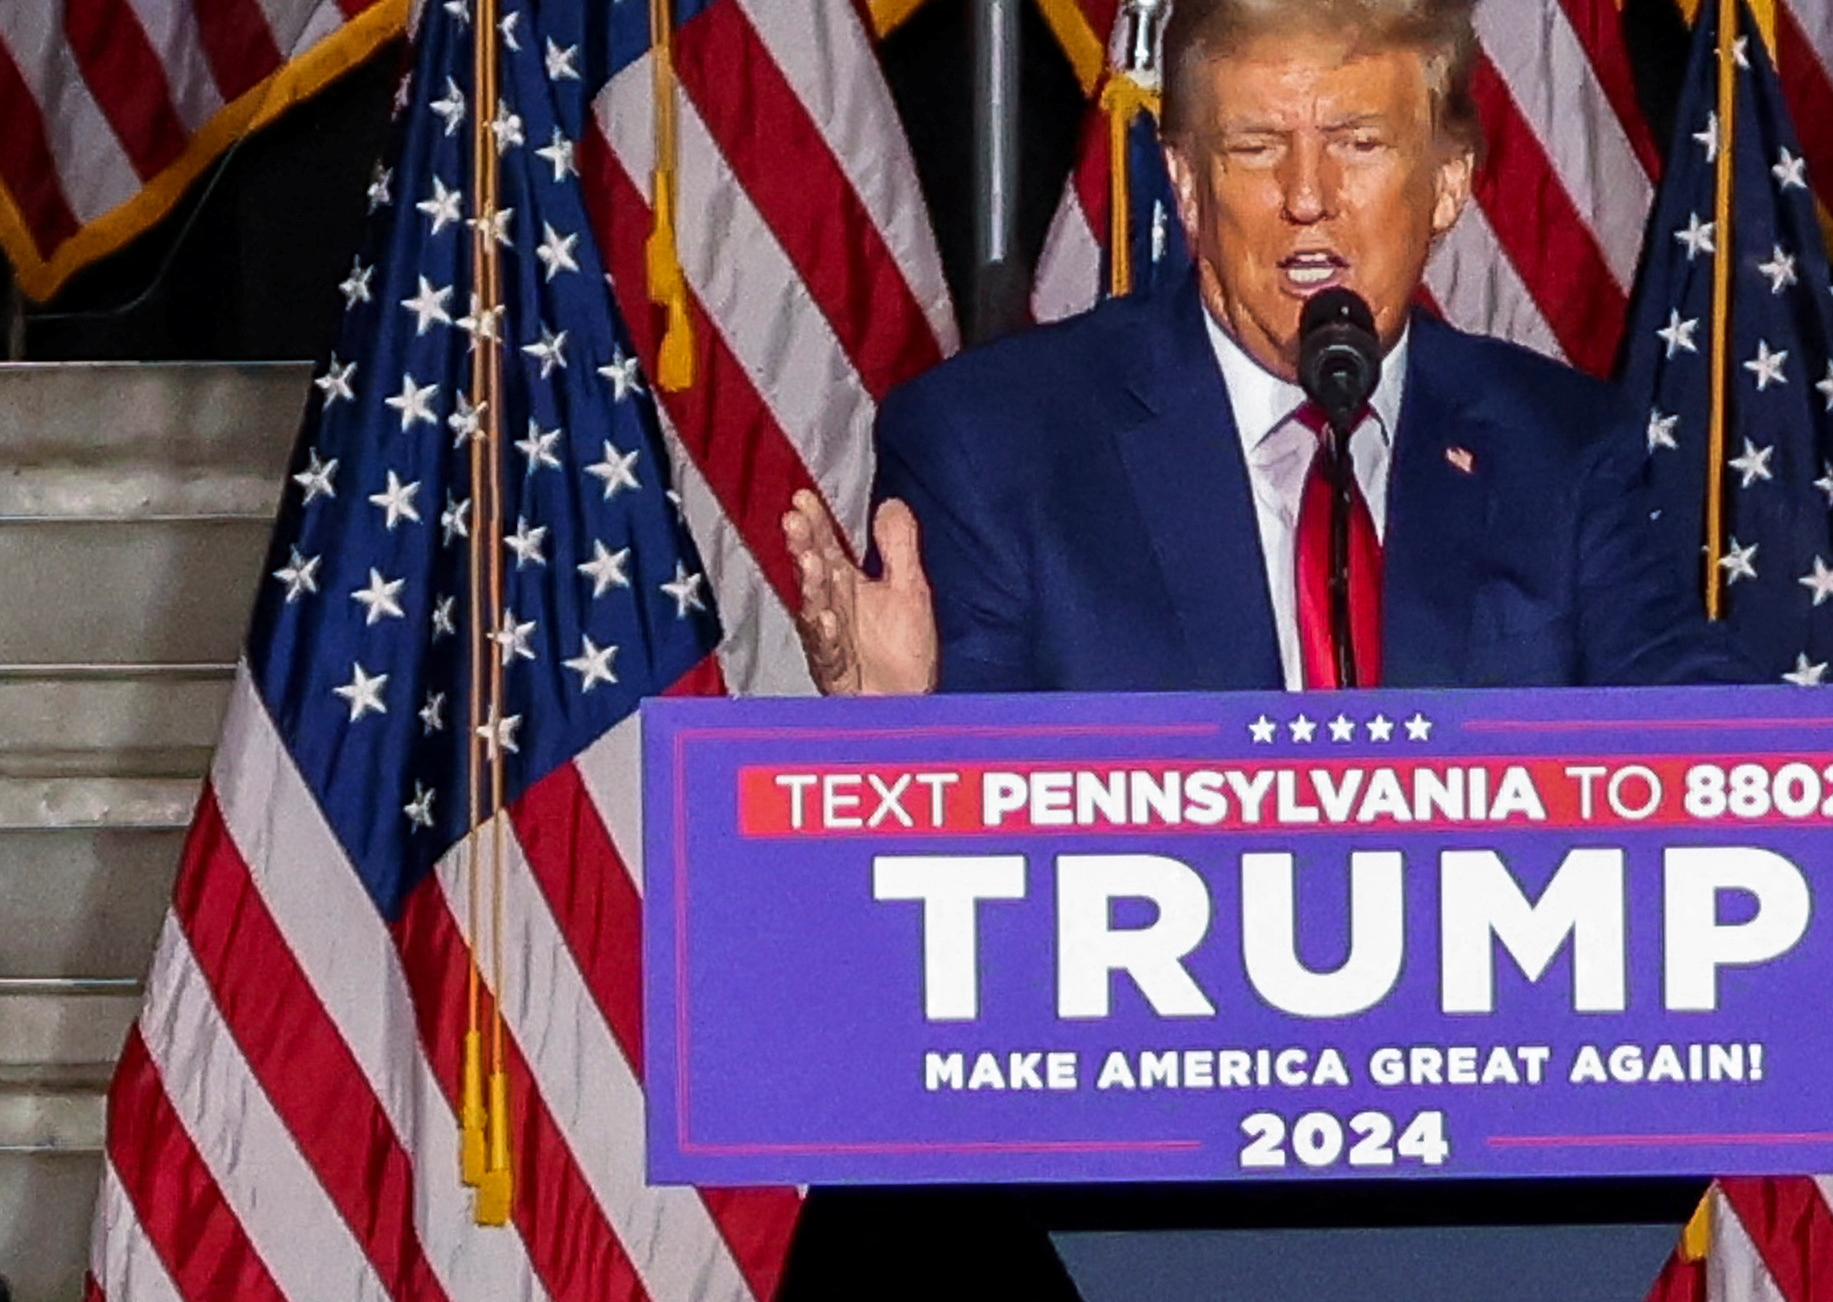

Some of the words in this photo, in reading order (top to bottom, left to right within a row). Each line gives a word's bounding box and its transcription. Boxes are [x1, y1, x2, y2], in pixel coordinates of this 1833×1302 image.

[774, 771, 960, 830] TEXT
[982, 765, 1547, 827] PENNSYLVANIA
[1564, 764, 1663, 821] TO
[872, 845, 1812, 1021] TRUMP
[924, 1051, 1078, 1092] MAKE
[1096, 1047, 1350, 1090] AMERICA
[1368, 1045, 1551, 1087] GREAT
[1569, 1042, 1764, 1084] AGAIN!
[1239, 1110, 1450, 1168] 2024
